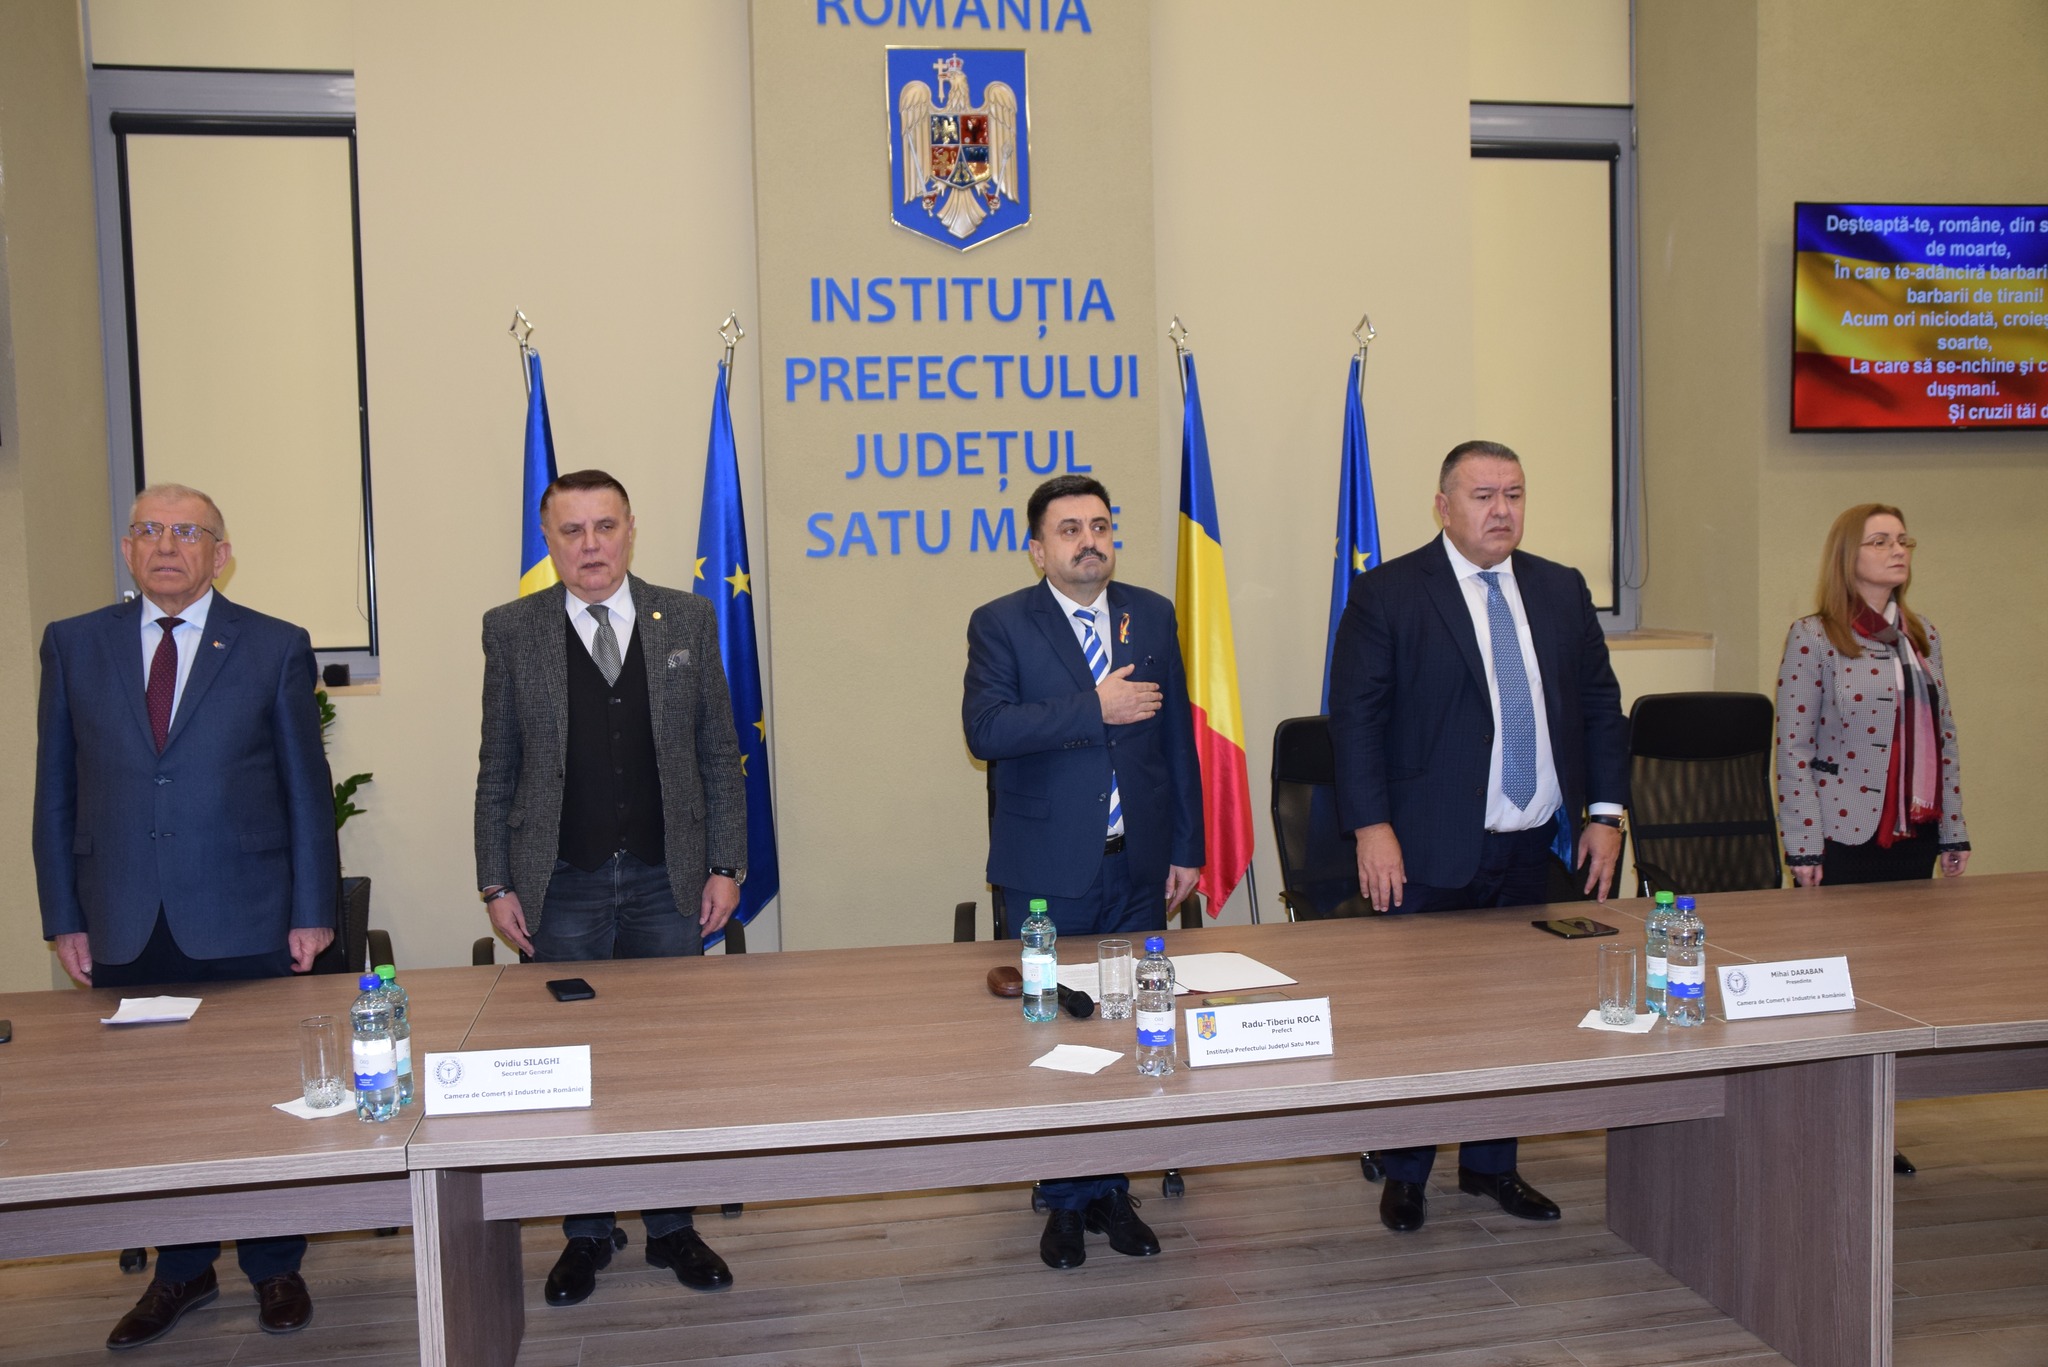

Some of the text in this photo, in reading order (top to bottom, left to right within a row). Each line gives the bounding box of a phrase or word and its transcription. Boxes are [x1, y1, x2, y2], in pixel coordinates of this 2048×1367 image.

[1938, 216, 2005, 236] române,
[2009, 216, 2036, 233] din
[1926, 240, 2011, 260] de moarte,
[1834, 259, 1850, 279] În
[1854, 266, 1891, 280] care
[1894, 263, 1985, 280] te-adânciră
[1906, 287, 2045, 304] barbarii de tirani!
[1841, 310, 1889, 327] Acum
[1893, 311, 1916, 327] ori
[1920, 311, 1999, 329] niciodată,
[1937, 335, 1993, 352] soarte,
[1849, 358, 1871, 374] La
[1874, 360, 1910, 374] care
[1913, 357, 1933, 374] să
[1937, 357, 2016, 374] se-nchine
[786, 355, 1138, 401] PREFECTULUI
[1968, 403, 2013, 419] cruzii
[2016, 402, 2036, 419] tăi
[806, 510, 950, 557] SATU
[1771, 968, 1824, 978] Mihai DARABAN
[1241, 1015, 1321, 1029] Radu-Tiberiu ROCA
[494, 1057, 561, 1068] Ovidiu SILAGHI
[501, 1069, 527, 1077] Secretar
[515, 1087, 546, 1096] Industrie
